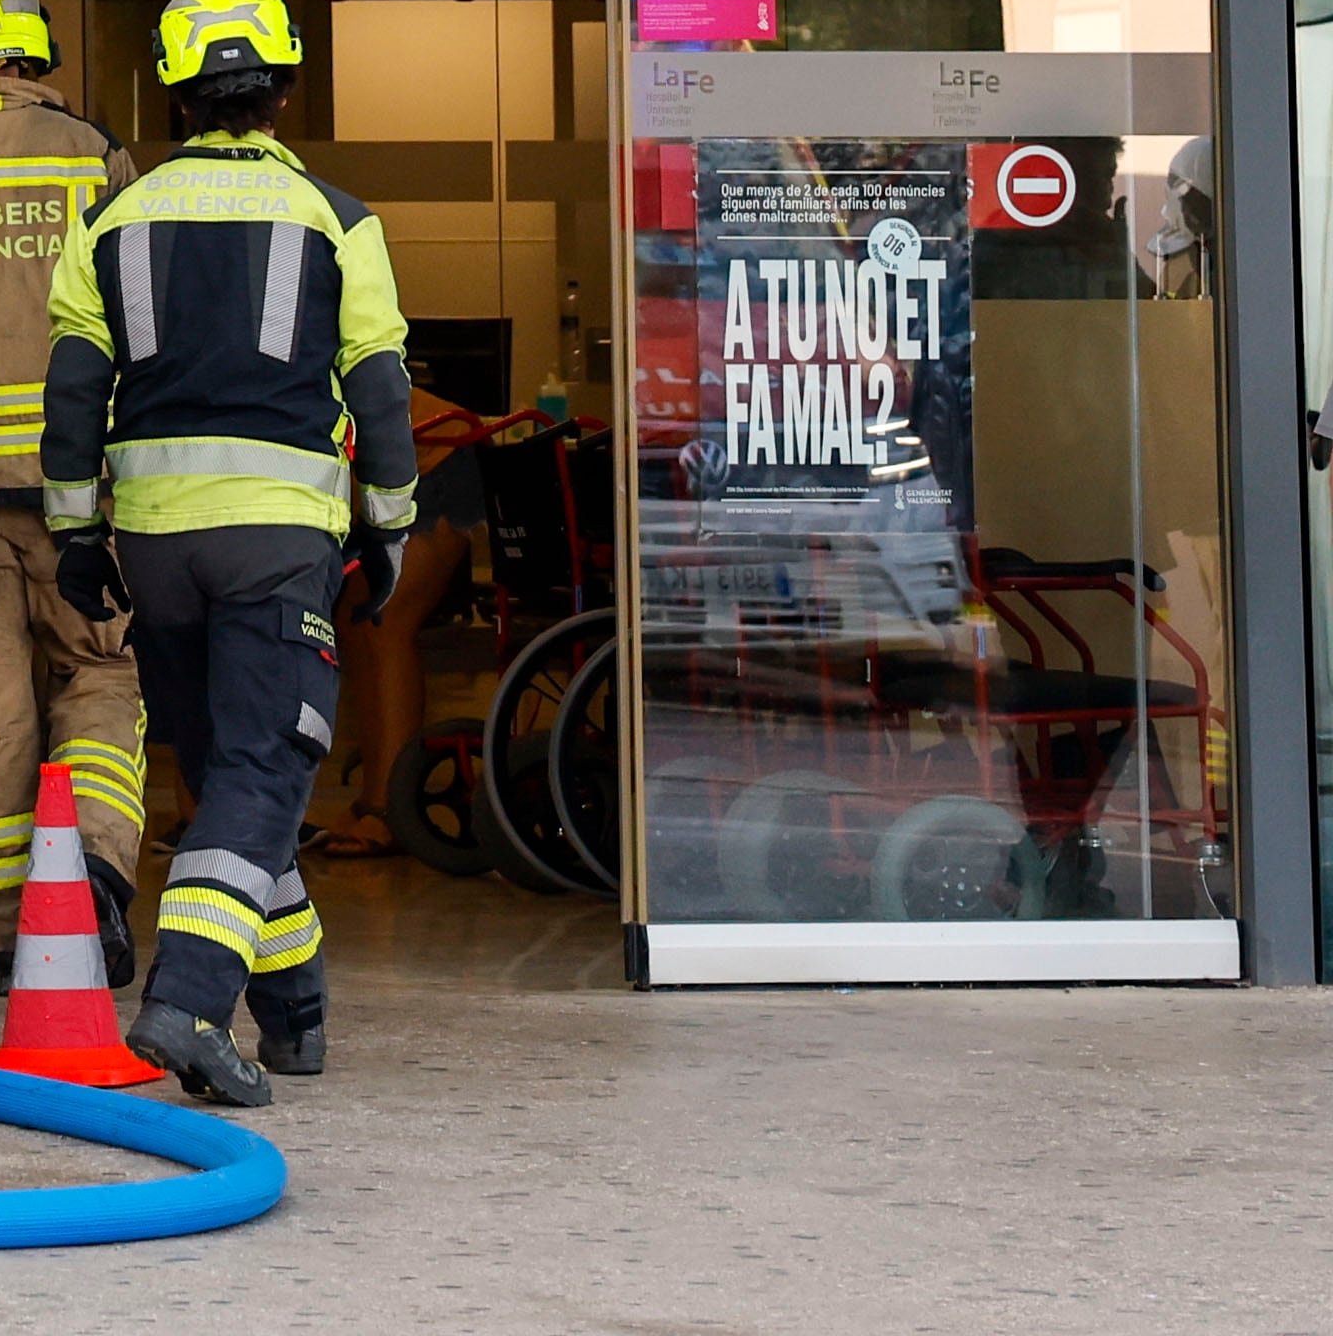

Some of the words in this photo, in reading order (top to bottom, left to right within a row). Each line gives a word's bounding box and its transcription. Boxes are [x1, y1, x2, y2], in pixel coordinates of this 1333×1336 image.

[653, 61, 679, 86] La
[683, 70, 715, 98] Fe
[940, 61, 965, 86] La
[969, 70, 1000, 98] Fe
[144, 171, 291, 192] BOMBERS
[721, 183, 744, 198] Que
[746, 186, 784, 202] menys
[786, 184, 802, 197] de
[804, 184, 812, 197] 2
[814, 184, 829, 197] de
[831, 184, 860, 197] cada
[862, 184, 882, 197] 100
[884, 184, 946, 198] denúncies
[139, 193, 291, 215] VALÈNCIA
[721, 198, 761, 212] siguen
[763, 198, 778, 210] de
[780, 198, 832, 210] familiars
[840, 198, 871, 210] afins
[872, 198, 887, 210] de
[889, 198, 907, 210] les
[721, 211, 757, 223] dones
[759, 211, 848, 224] maltractades...
[882, 232, 906, 257] 016
[723, 259, 755, 360] A
[759, 259, 818, 361] TU
[825, 259, 888, 361] NO
[894, 260, 947, 360] ET
[725, 364, 777, 465] FA
[782, 364, 895, 465] MAL?
[906, 488, 953, 497] GENERALITAT
[906, 496, 952, 505] VALENCIANA
